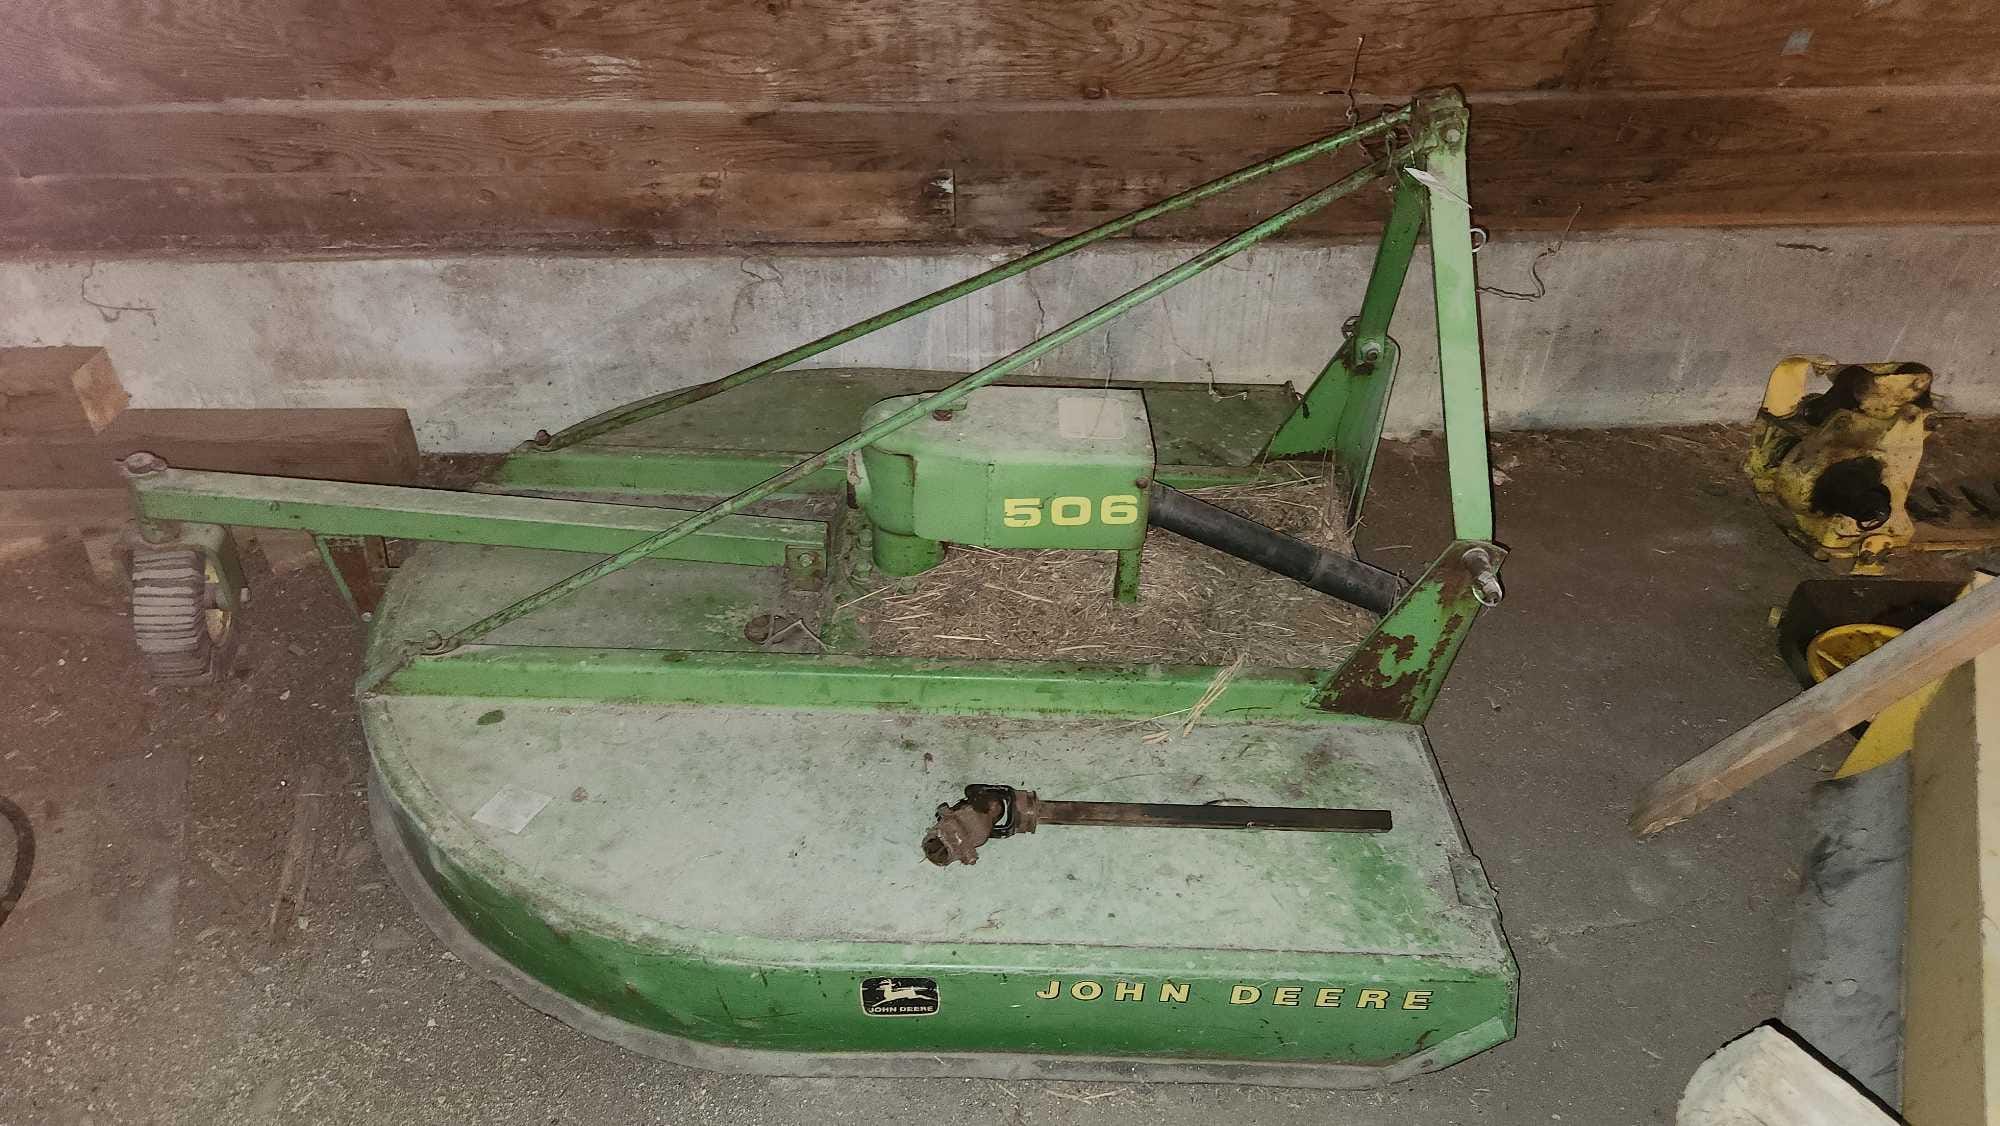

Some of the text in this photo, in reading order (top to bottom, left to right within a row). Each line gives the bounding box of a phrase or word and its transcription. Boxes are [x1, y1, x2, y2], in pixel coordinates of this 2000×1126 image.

[1003, 494, 1138, 528] 506
[1035, 980, 1433, 1010] JOHN DEERE
